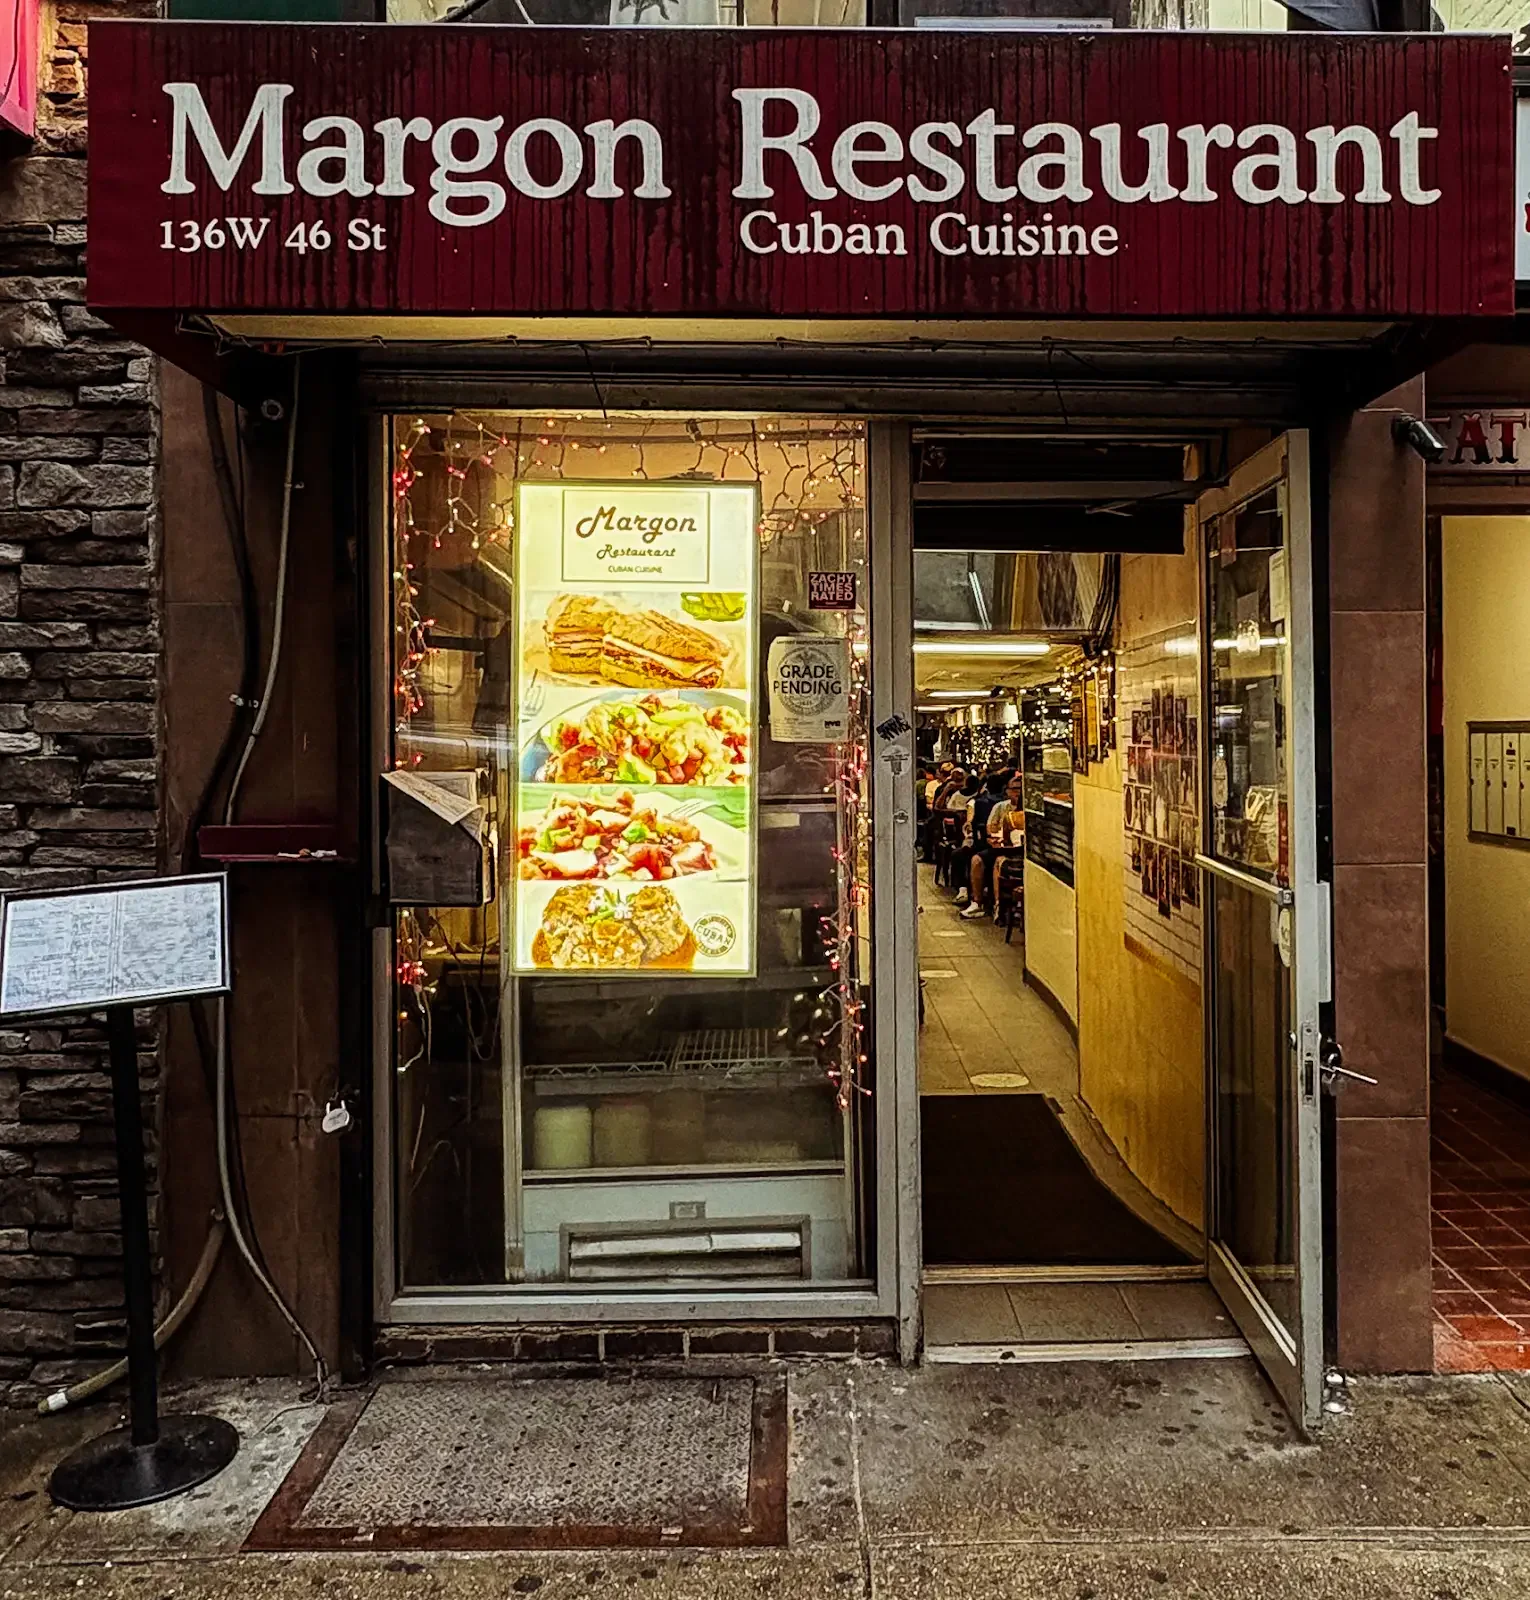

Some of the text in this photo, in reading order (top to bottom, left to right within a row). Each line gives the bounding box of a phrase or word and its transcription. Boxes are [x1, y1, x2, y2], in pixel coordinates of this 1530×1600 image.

[160, 82, 1441, 227] Margon Restaurant
[160, 217, 387, 254] 136W 46 St
[740, 210, 1119, 256] Cuban Cuisine
[576, 505, 697, 543] Margon
[596, 543, 677, 560] Restaurant
[607, 565, 663, 574] CUBAN CUISINE
[810, 581, 853, 592] TIMES
[811, 591, 854, 601] RATED
[780, 664, 834, 679] GRADE
[773, 680, 842, 695] PENDING
